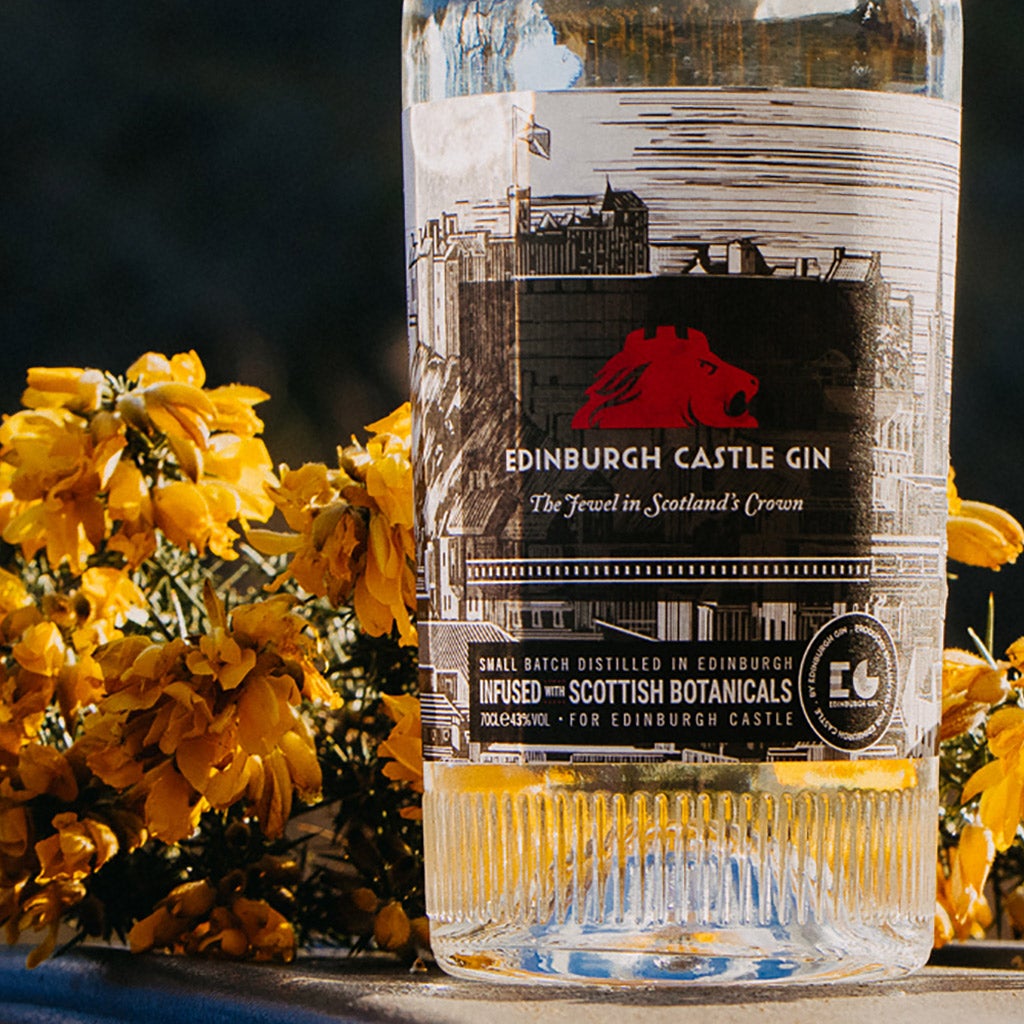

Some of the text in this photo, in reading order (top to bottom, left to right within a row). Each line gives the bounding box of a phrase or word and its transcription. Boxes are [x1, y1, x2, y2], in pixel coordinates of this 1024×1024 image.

[505, 445, 832, 472] EDINBURGH CASTLE GIN
[529, 492, 805, 519] The Jewel in Scotland's Crown
[479, 656, 793, 672] SMALL BATCH DISTILLED IN EDINBURGH
[479, 678, 793, 705] INFUSED WITH SCOTTISH BOTANICALS
[569, 712, 600, 727] FOR
[611, 712, 718, 727] EDINBURGH
[729, 712, 793, 726] CASTLE
